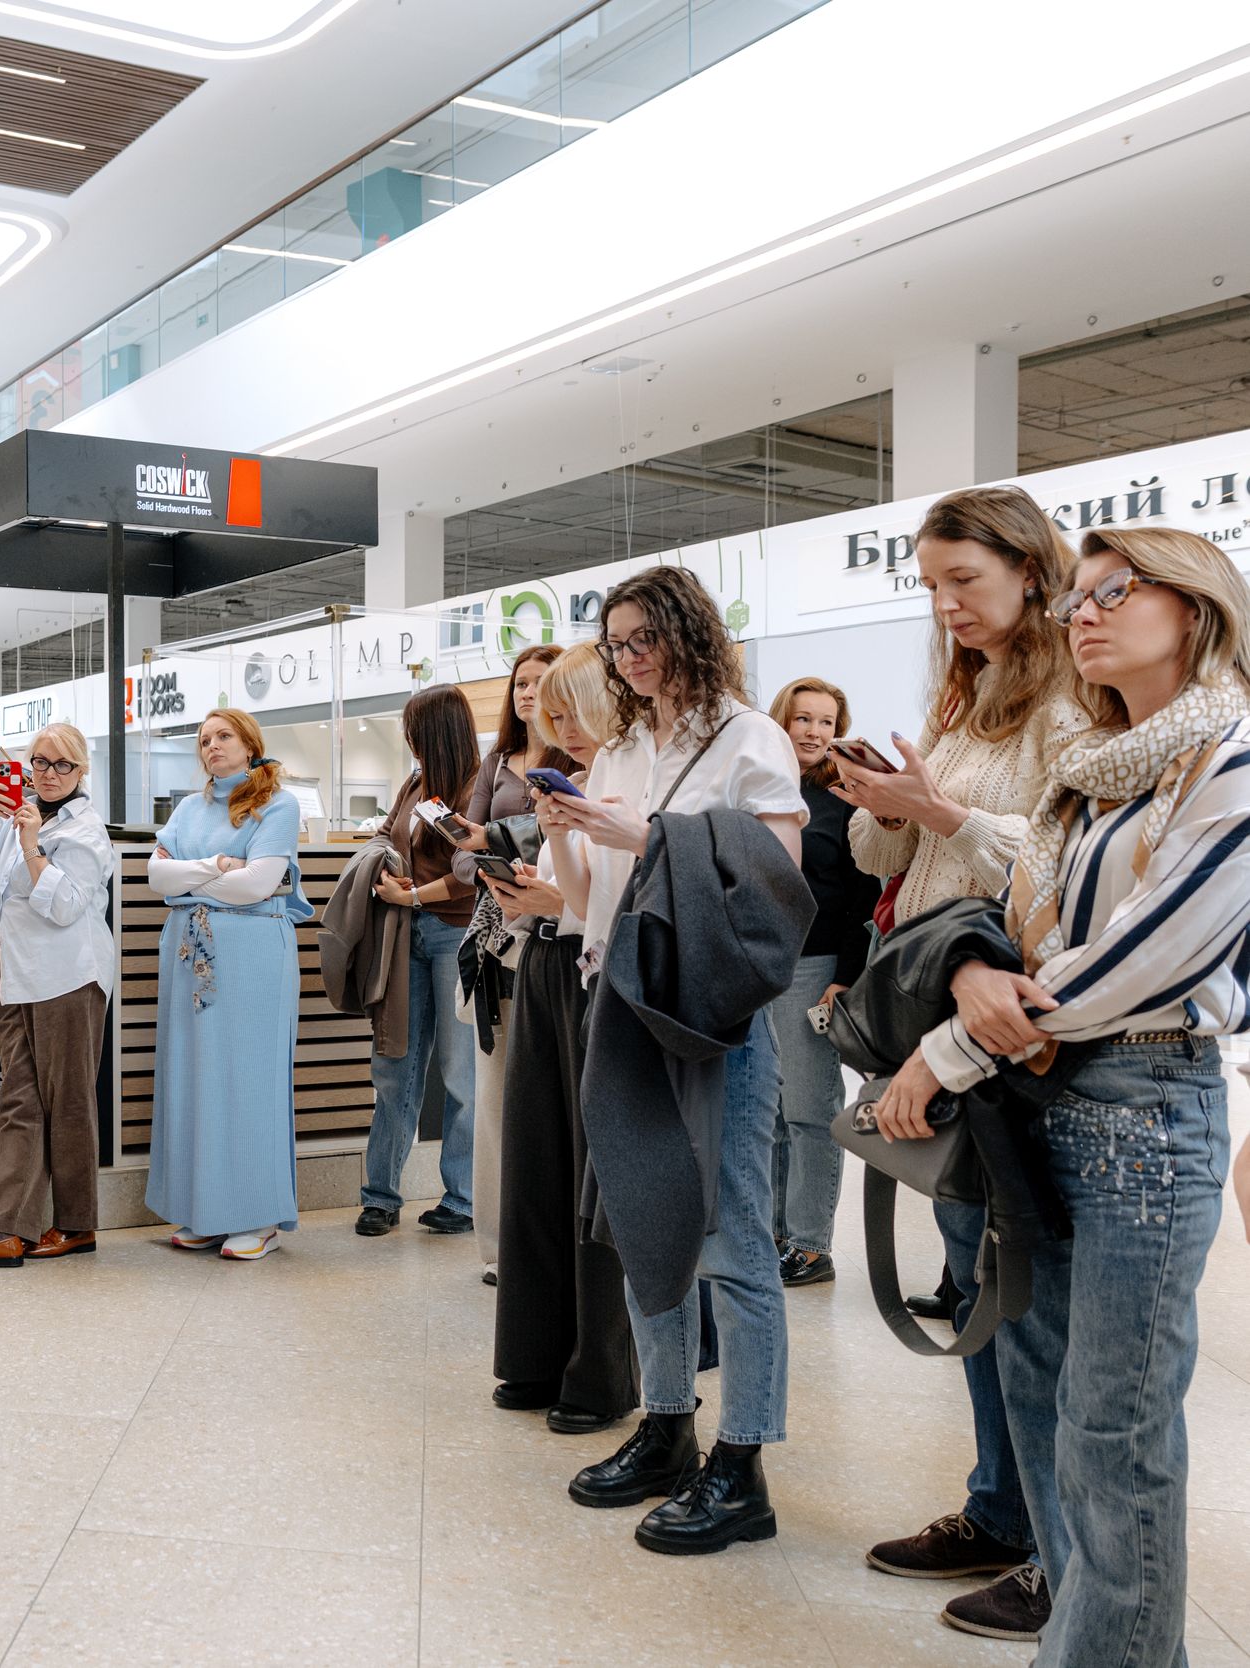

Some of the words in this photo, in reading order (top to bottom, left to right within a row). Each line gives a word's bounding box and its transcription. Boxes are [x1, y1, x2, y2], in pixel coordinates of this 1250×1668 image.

[136, 500, 154, 511] Solid
[155, 502, 190, 515] Hardwood
[191, 505, 212, 517] Floors
